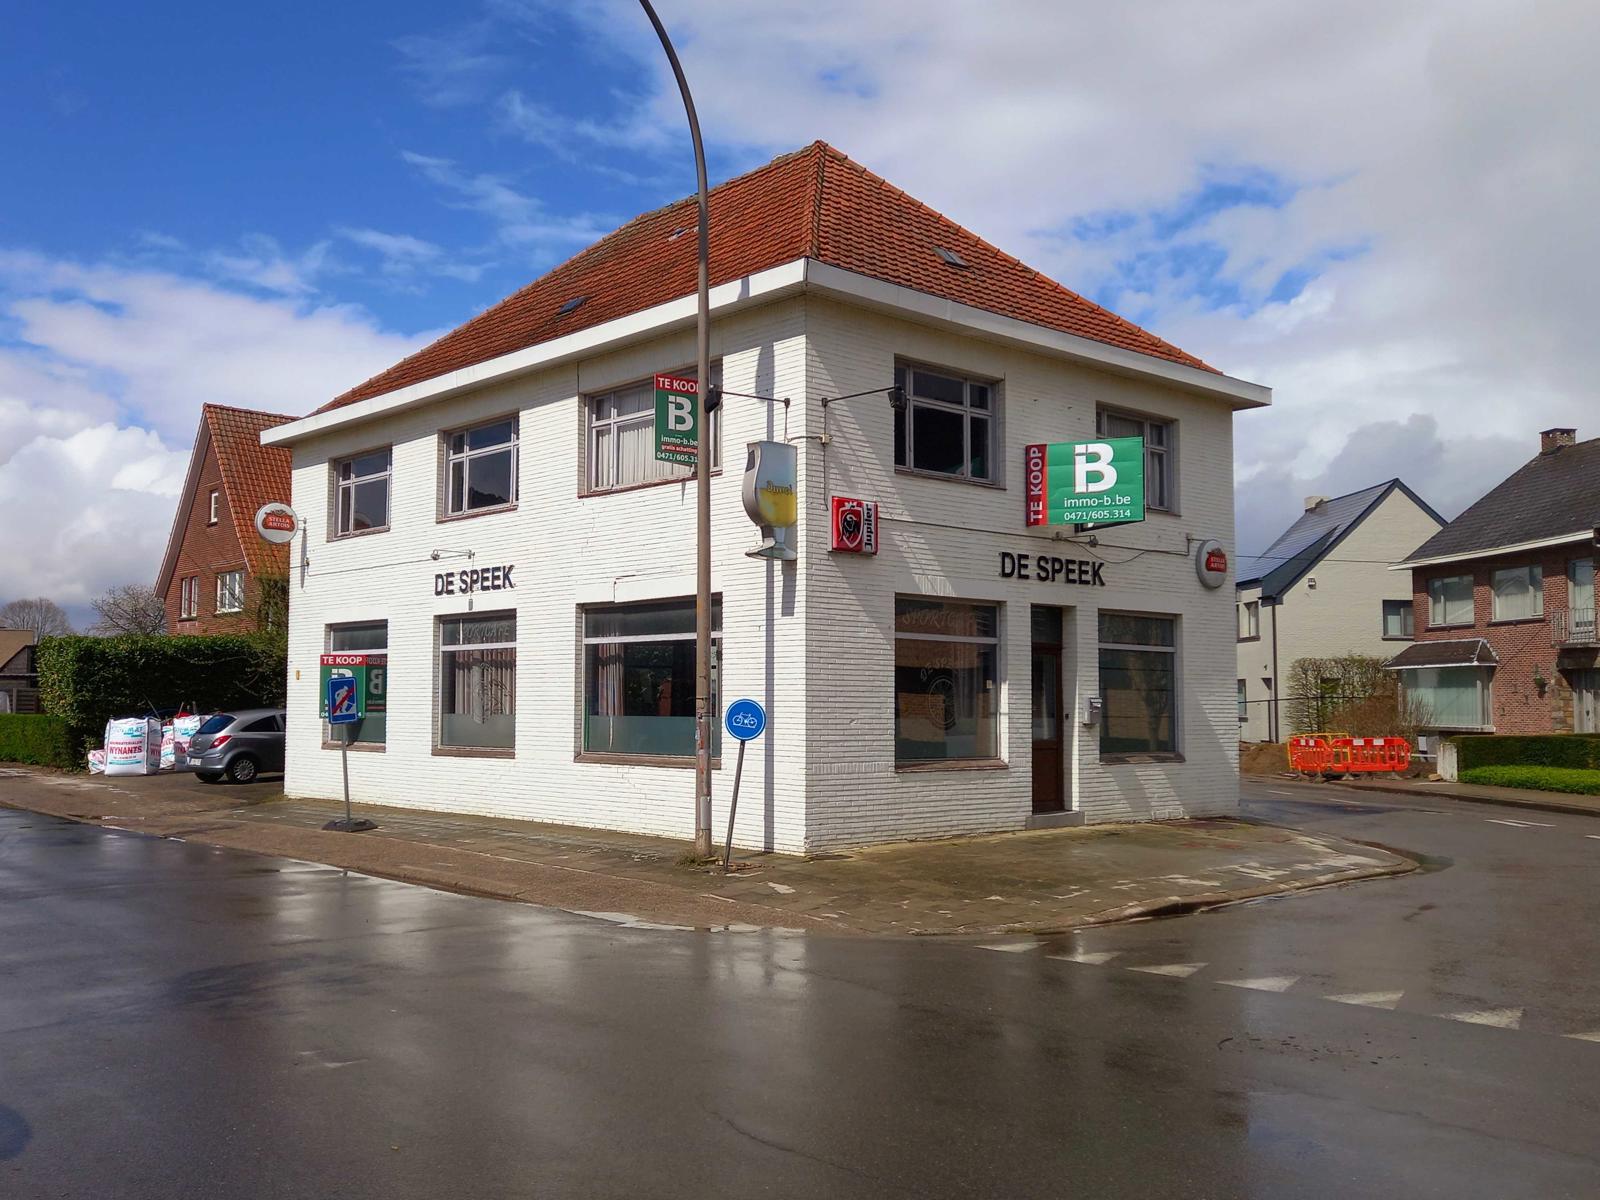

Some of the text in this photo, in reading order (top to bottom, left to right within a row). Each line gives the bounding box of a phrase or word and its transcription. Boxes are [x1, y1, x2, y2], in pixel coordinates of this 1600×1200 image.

[657, 378, 698, 392] TE KOO
[661, 434, 698, 446] immo-b.be
[656, 451, 698, 463] 0471/605.31
[1030, 447, 1043, 522] TE KOOP
[1064, 494, 1131, 508] immo-b.be
[1064, 509, 1131, 521] 0471/605.314
[864, 503, 873, 550] Jupiler
[1000, 551, 1106, 587] DE SPEEK
[434, 564, 515, 597] DE SPEEK
[322, 656, 363, 665] TE KOOP
